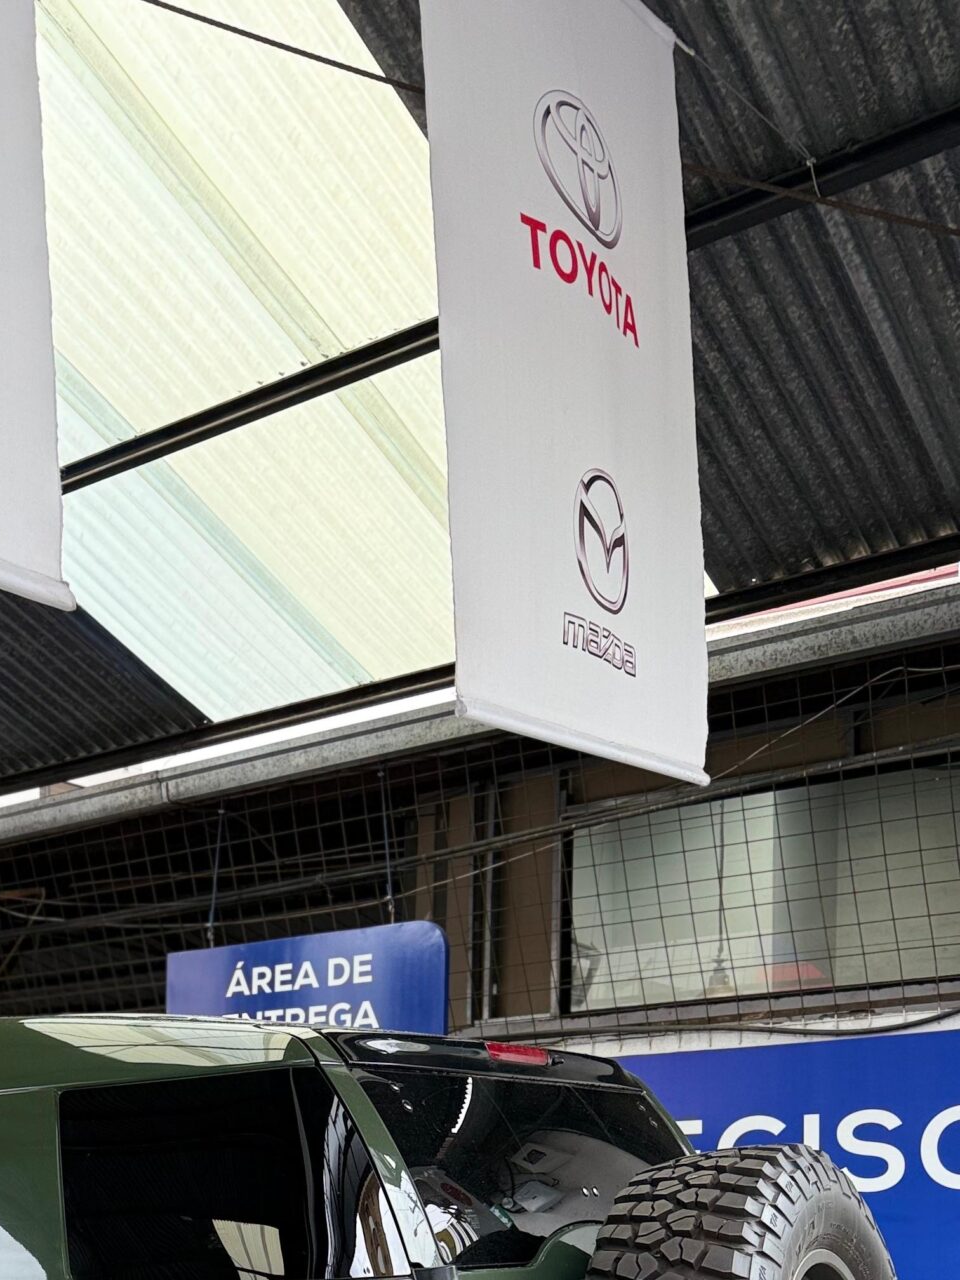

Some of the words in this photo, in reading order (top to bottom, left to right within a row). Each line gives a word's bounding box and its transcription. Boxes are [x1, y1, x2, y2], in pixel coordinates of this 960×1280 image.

[520, 212, 639, 348] TOYOTA
[562, 611, 637, 677] mazda
[226, 961, 319, 998] ÁREA
[328, 953, 373, 987] DE
[222, 1000, 380, 1029] REGA
